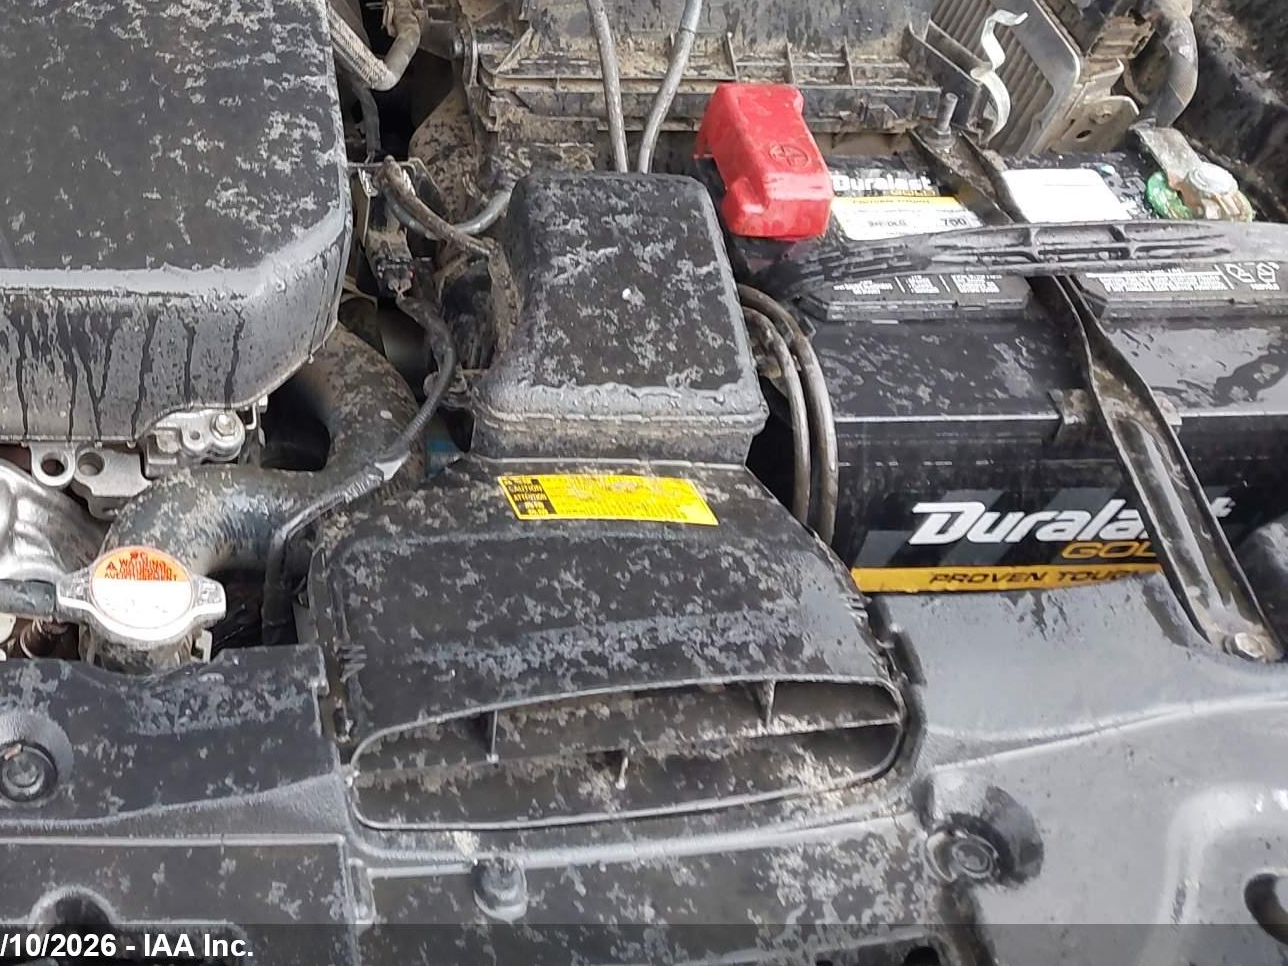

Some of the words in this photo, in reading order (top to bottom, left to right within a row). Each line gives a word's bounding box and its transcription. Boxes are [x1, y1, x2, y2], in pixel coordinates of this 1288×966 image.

[831, 172, 932, 191] Duralast
[909, 498, 1236, 545] Duralat
[1062, 541, 1157, 559] GOL
[928, 570, 1049, 585] PROVEN
